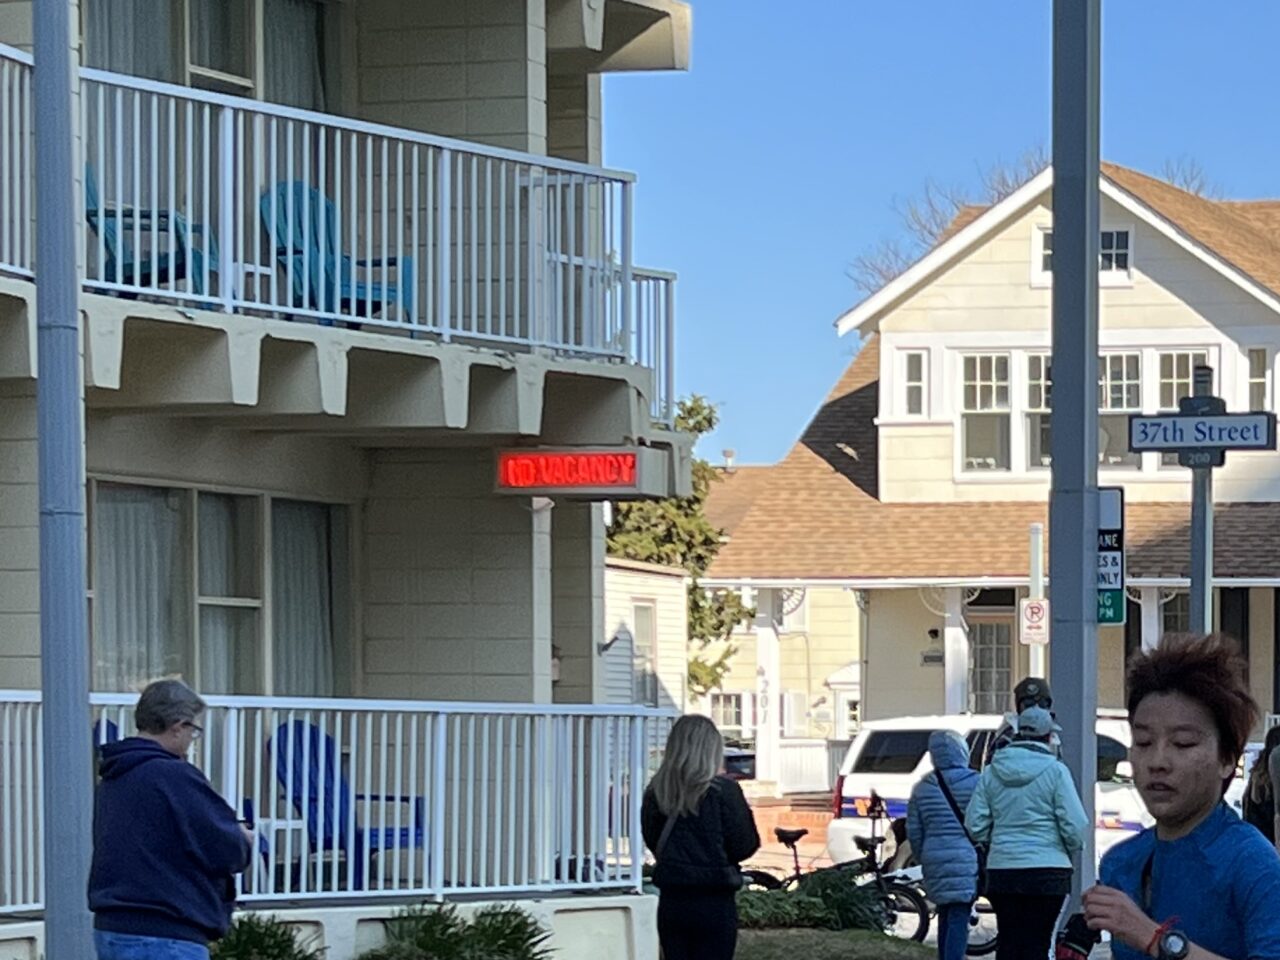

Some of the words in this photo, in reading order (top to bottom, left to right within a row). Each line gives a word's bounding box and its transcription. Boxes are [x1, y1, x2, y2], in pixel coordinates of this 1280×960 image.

[1137, 420, 1184, 443] 37th
[1194, 420, 1260, 442] Street
[538, 454, 635, 484] VACANCY
[1099, 534, 1119, 548] ANE
